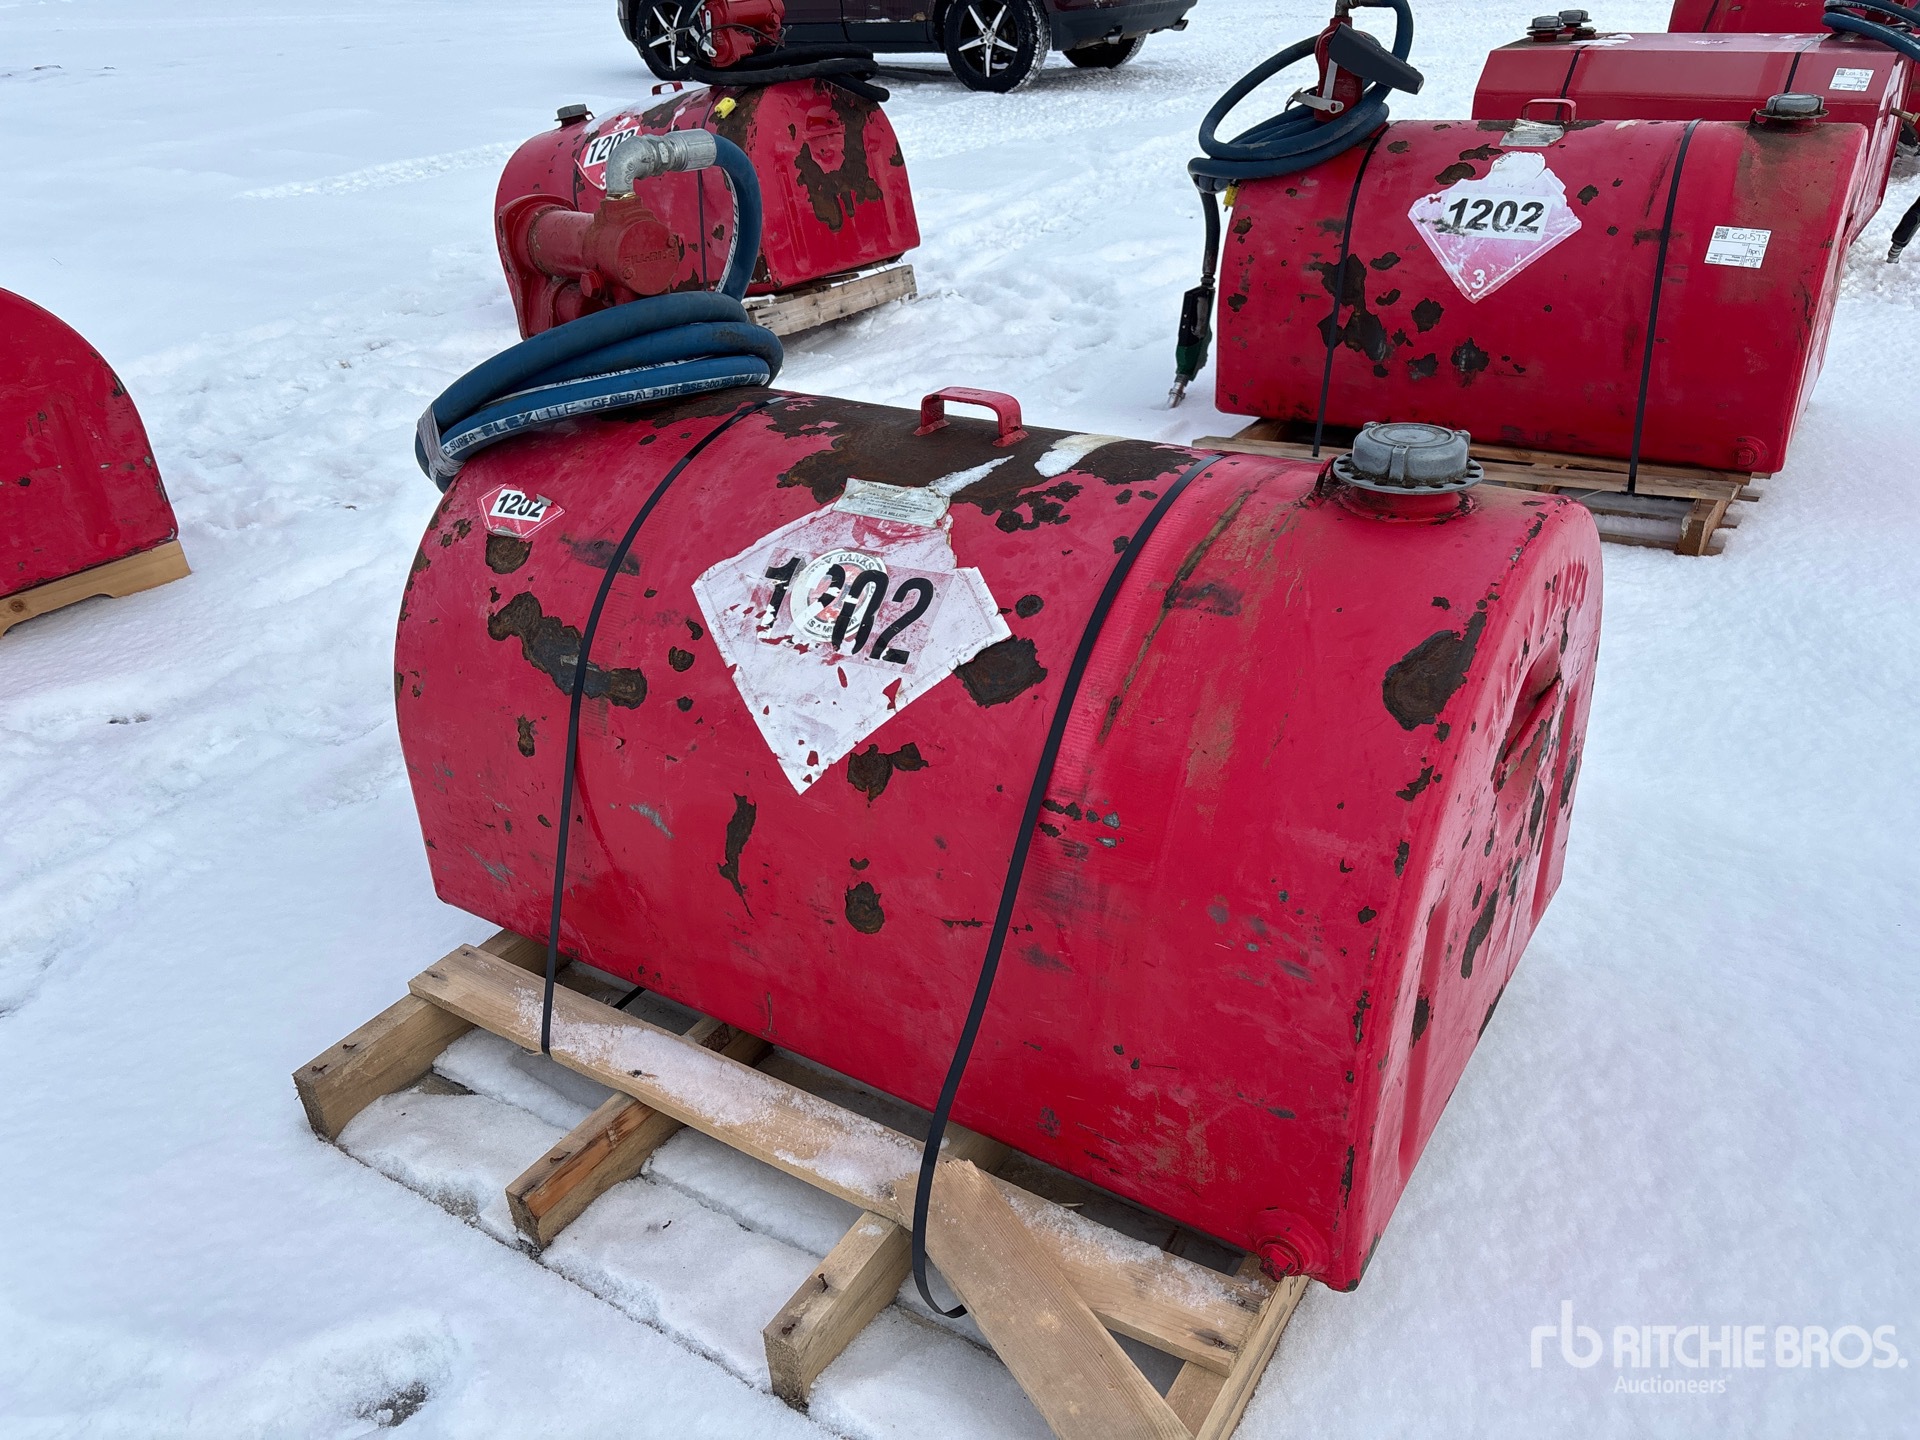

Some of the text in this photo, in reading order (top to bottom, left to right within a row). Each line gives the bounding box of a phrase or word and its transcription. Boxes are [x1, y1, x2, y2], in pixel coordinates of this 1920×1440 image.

[1448, 198, 1545, 234] 1202
[1470, 269, 1487, 289] 3
[450, 432, 477, 451] SUPER
[480, 402, 577, 437] FLEXLITE
[591, 389, 650, 408] GENERAL
[652, 381, 703, 397] PURPOSE
[703, 379, 720, 390] 300
[498, 493, 544, 518] 1202
[837, 553, 875, 570] TANKS
